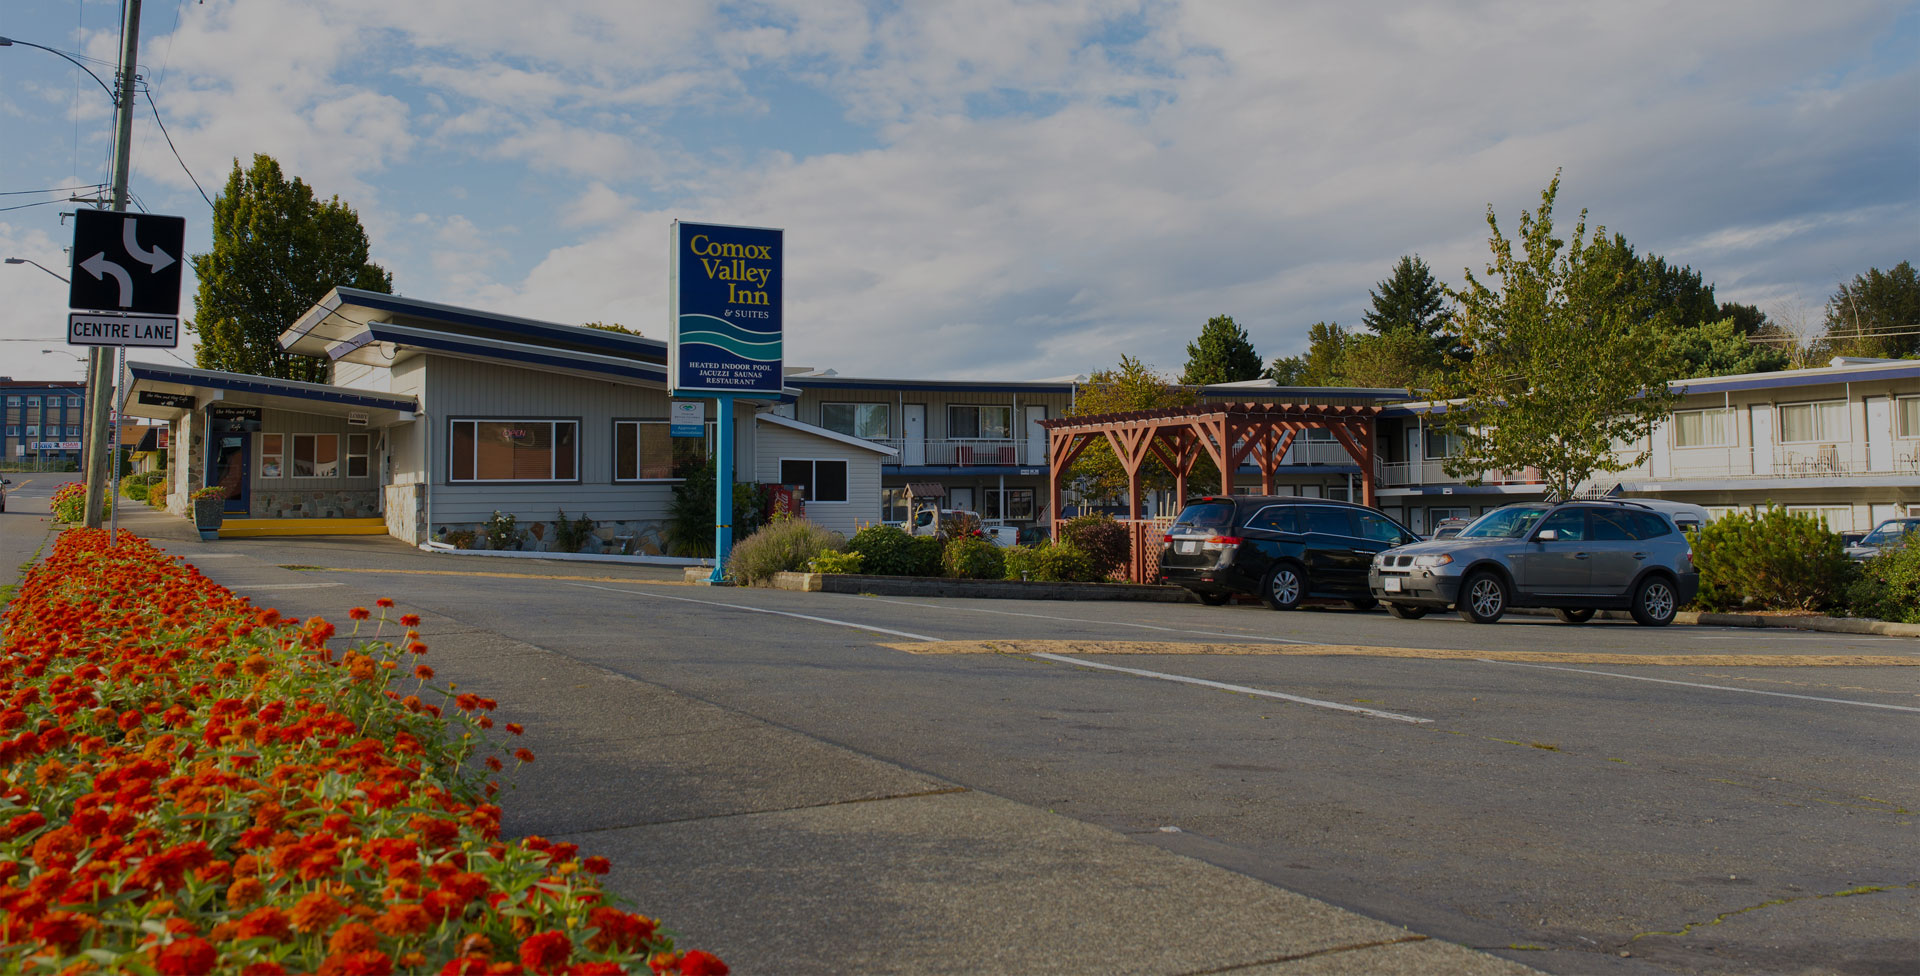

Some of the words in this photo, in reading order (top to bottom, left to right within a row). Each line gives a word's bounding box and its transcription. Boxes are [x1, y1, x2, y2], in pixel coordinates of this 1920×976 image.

[690, 234, 772, 260] Comox
[700, 258, 772, 288] Valley
[727, 283, 770, 306] Inn
[724, 309, 733, 317] &
[735, 309, 769, 319] SUITES
[73, 322, 130, 338] CENTRE
[134, 324, 173, 340] LANE
[689, 361, 720, 369] HEATED
[721, 363, 750, 371] INDOOR
[706, 377, 756, 385] RESTAURANT
[502, 429, 526, 438] OPEN
